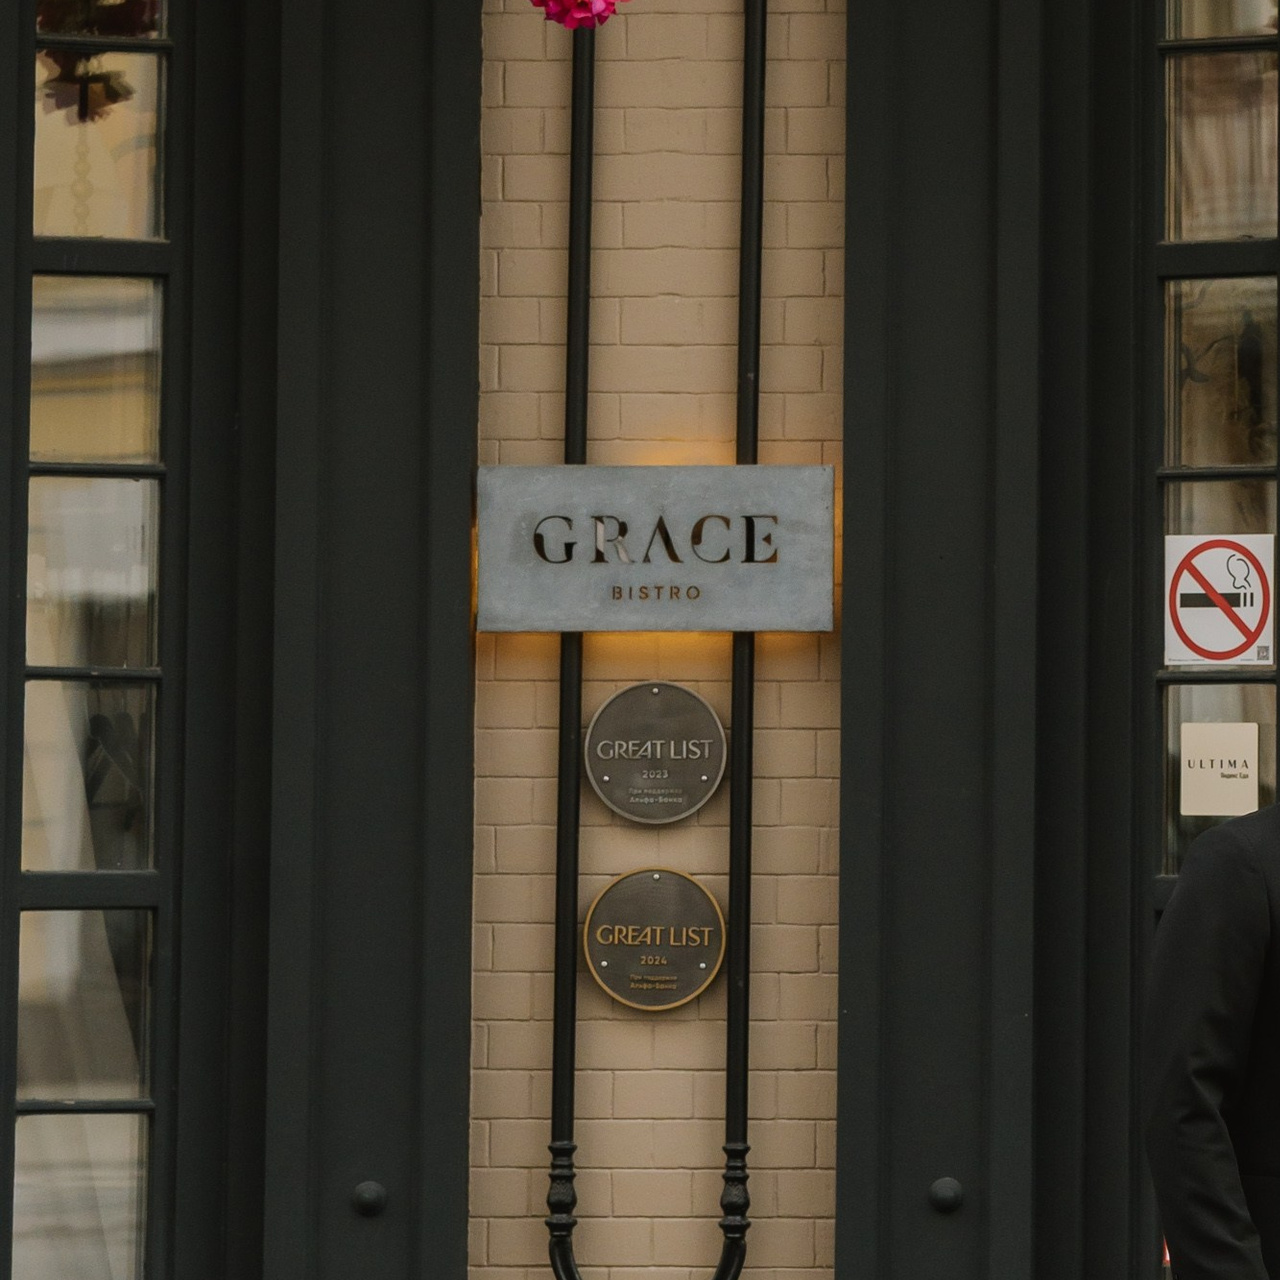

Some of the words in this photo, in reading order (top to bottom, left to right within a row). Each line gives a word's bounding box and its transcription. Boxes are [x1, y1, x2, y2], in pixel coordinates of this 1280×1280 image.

[533, 515, 779, 564] GRACE
[611, 585, 701, 601] BISTRO
[597, 740, 666, 759] GREAT
[670, 740, 714, 759] LIST
[1187, 759, 1249, 769] ULTIMA
[642, 769, 669, 779] 2023
[596, 924, 665, 945] GREAT
[669, 926, 714, 946] LIST
[640, 955, 668, 965] 2024
